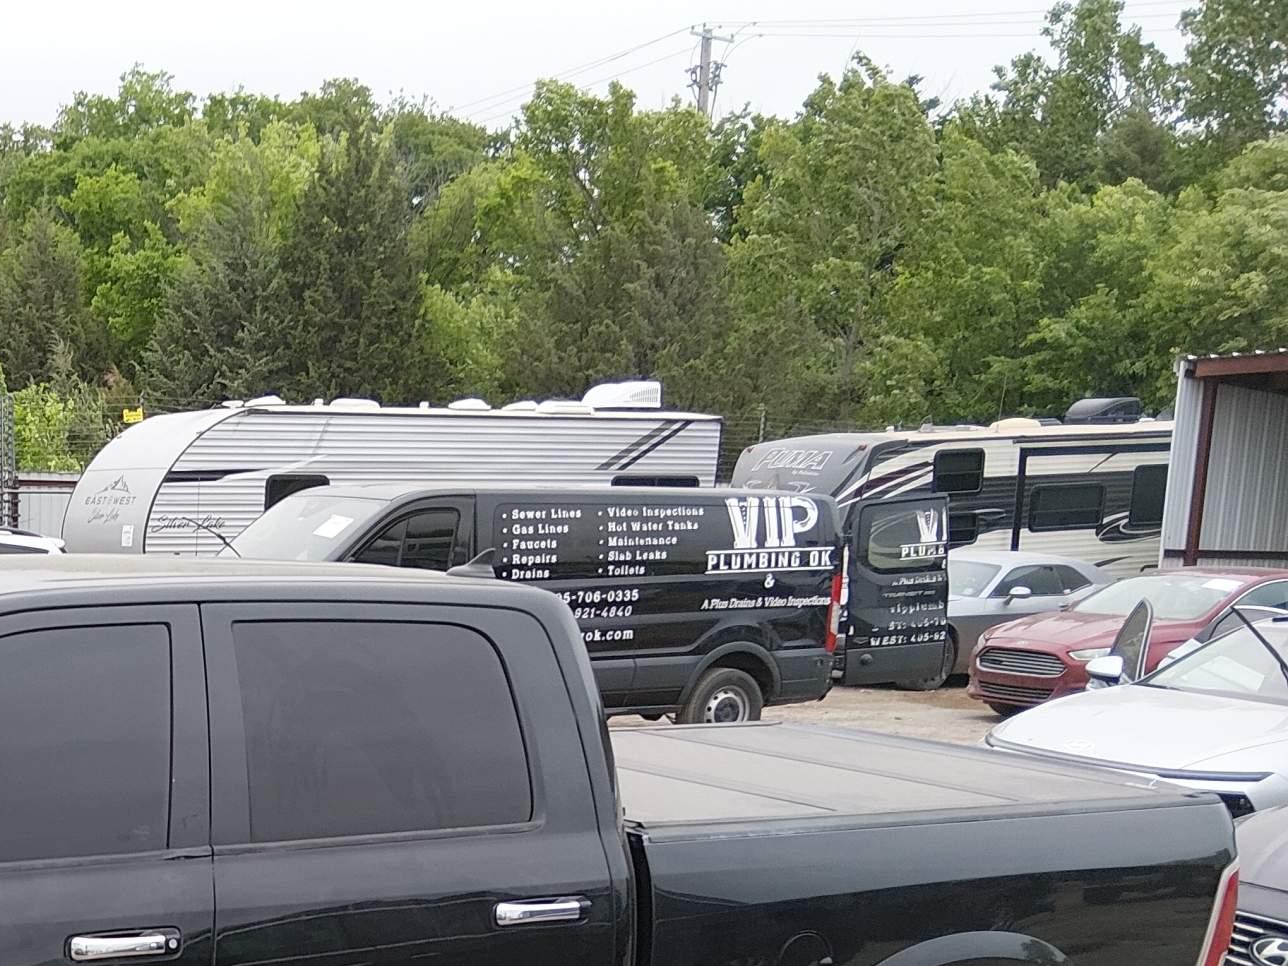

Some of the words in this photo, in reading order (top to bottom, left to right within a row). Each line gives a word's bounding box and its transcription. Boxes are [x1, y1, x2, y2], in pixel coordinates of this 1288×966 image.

[85, 496, 108, 505] EAST
[113, 496, 137, 505] WEST
[512, 509, 547, 520] Sewer
[551, 508, 581, 519] Lines
[607, 507, 638, 518] Video
[643, 506, 704, 518] Inspections
[607, 521, 627, 532] Hot
[631, 521, 663, 532] Water
[666, 520, 699, 531] Tanks
[725, 496, 818, 549] VIP
[512, 524, 534, 535] Gas
[538, 523, 569, 534] Lines
[512, 538, 557, 549] Faucets
[607, 536, 678, 547] Maintenance
[512, 553, 558, 565] Repairs
[607, 550, 632, 561] Slab
[635, 549, 668, 560] Leaks
[707, 551, 800, 571] PLUMBING
[809, 550, 832, 567] OK
[512, 568, 550, 580] Drains
[607, 565, 645, 576] Toilets
[764, 573, 775, 588] &
[729, 598, 755, 608] Drains
[764, 597, 786, 608] Video
[787, 595, 831, 608] Inspections
[580, 629, 634, 641] ok.com
